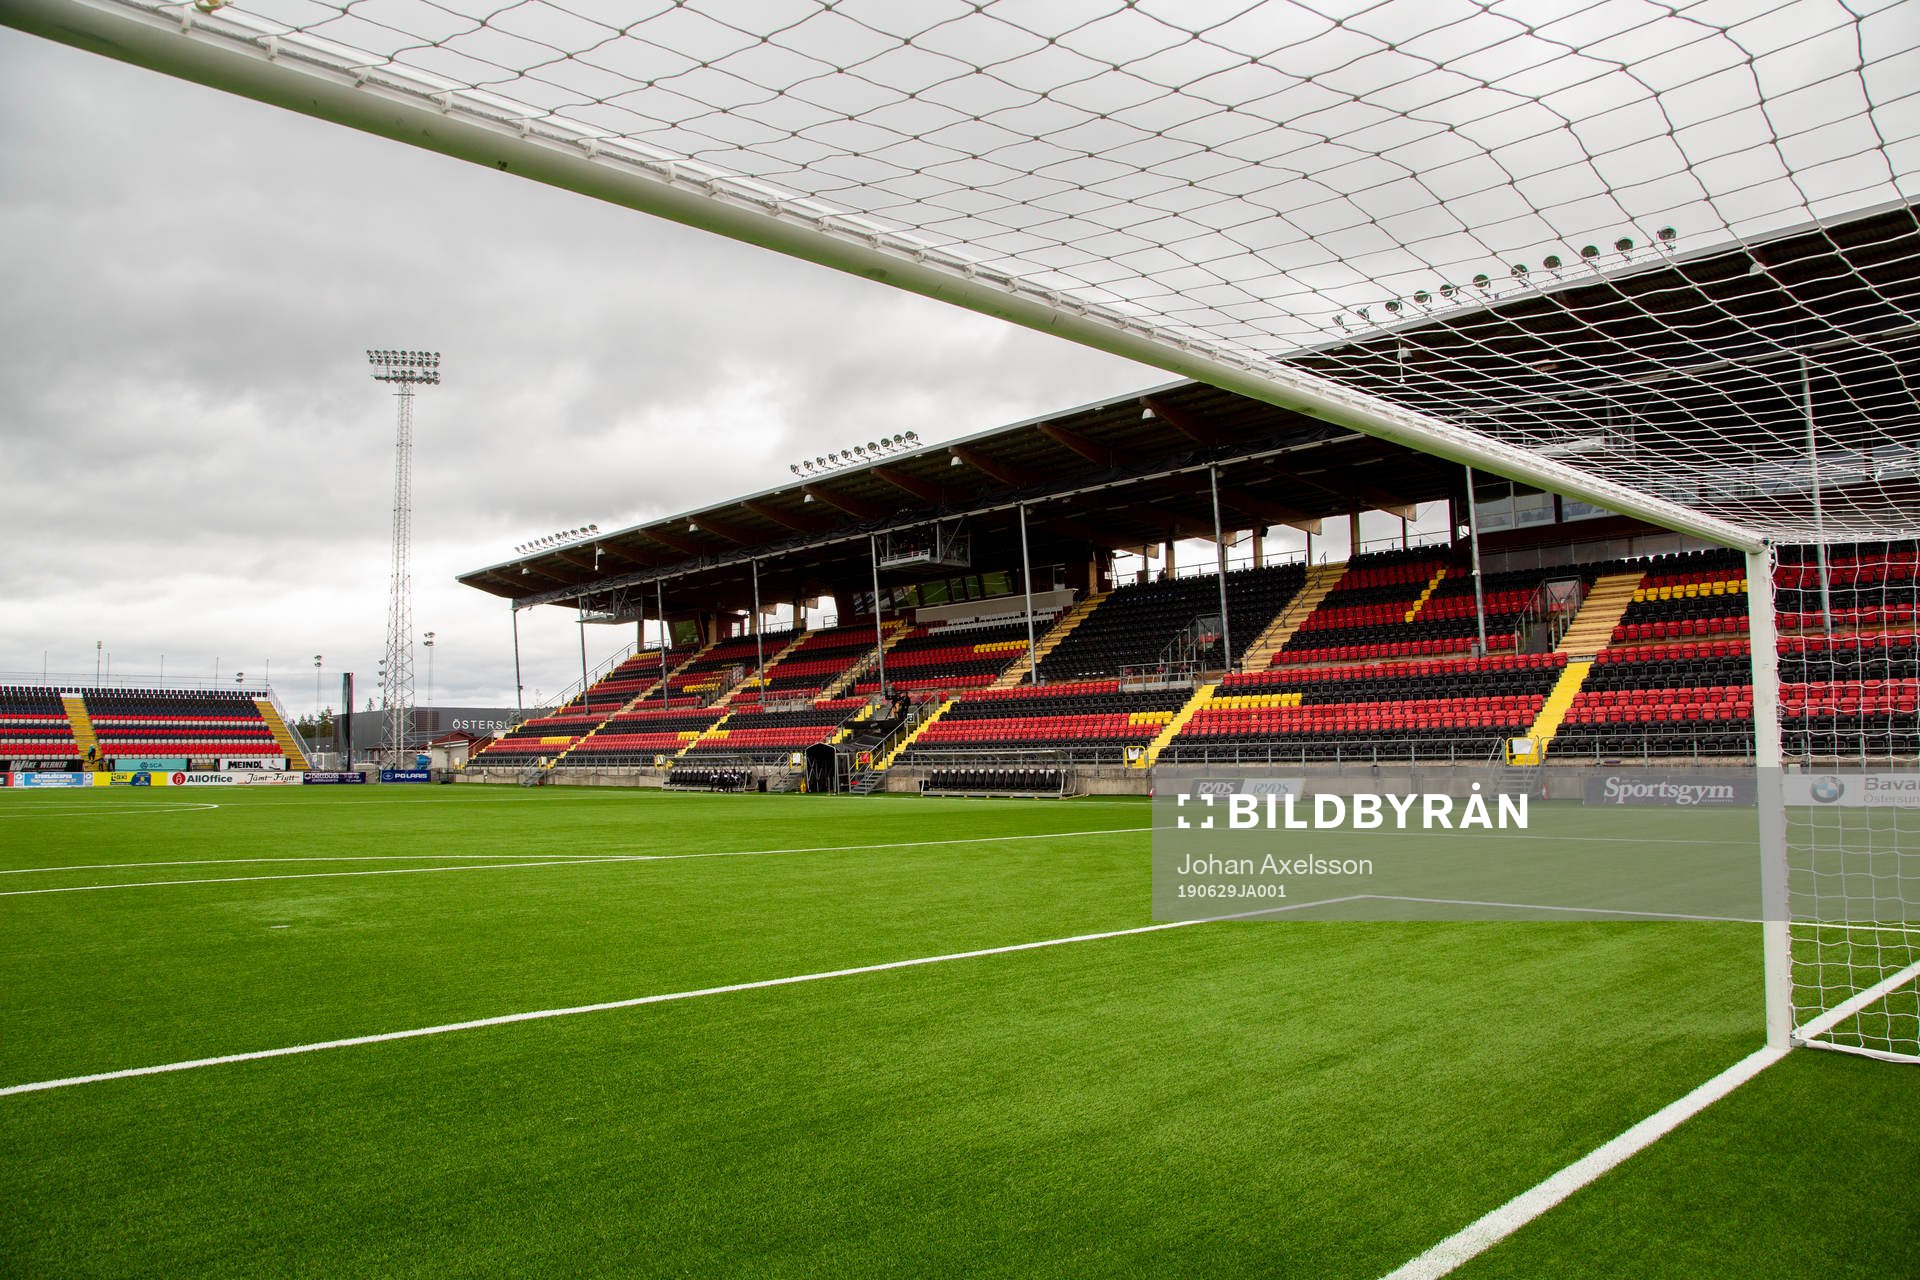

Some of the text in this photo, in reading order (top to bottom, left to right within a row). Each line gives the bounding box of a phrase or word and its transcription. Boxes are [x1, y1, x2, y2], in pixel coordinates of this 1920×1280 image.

[187, 774, 233, 783] AllOffice
[1197, 782, 1236, 794] RYDS
[1253, 783, 1290, 794] RYDS
[1604, 777, 1734, 805] Sportsgym
